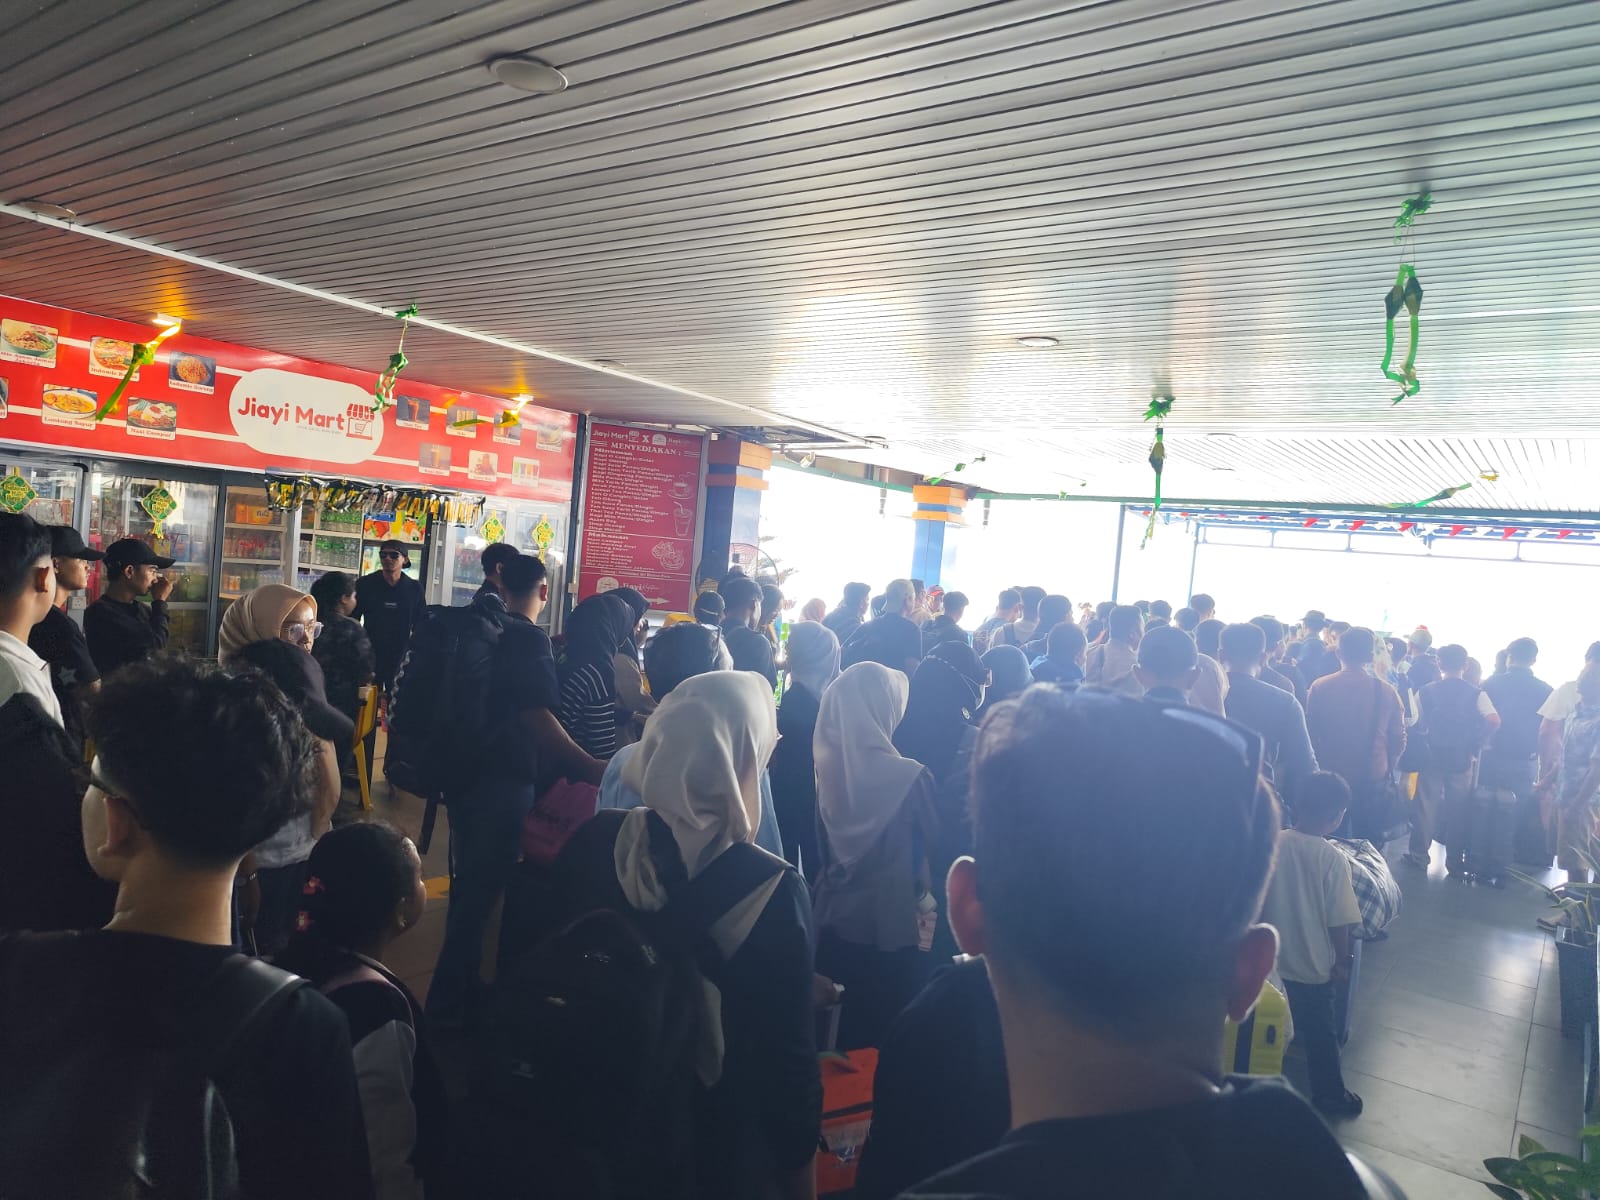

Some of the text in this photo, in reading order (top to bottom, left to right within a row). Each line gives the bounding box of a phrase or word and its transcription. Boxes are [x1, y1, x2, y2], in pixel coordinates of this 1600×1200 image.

[91, 367, 117, 376] Indomie
[238, 397, 344, 430] Jiayi Mart
[611, 442, 676, 455] MENYEDIAKAN
